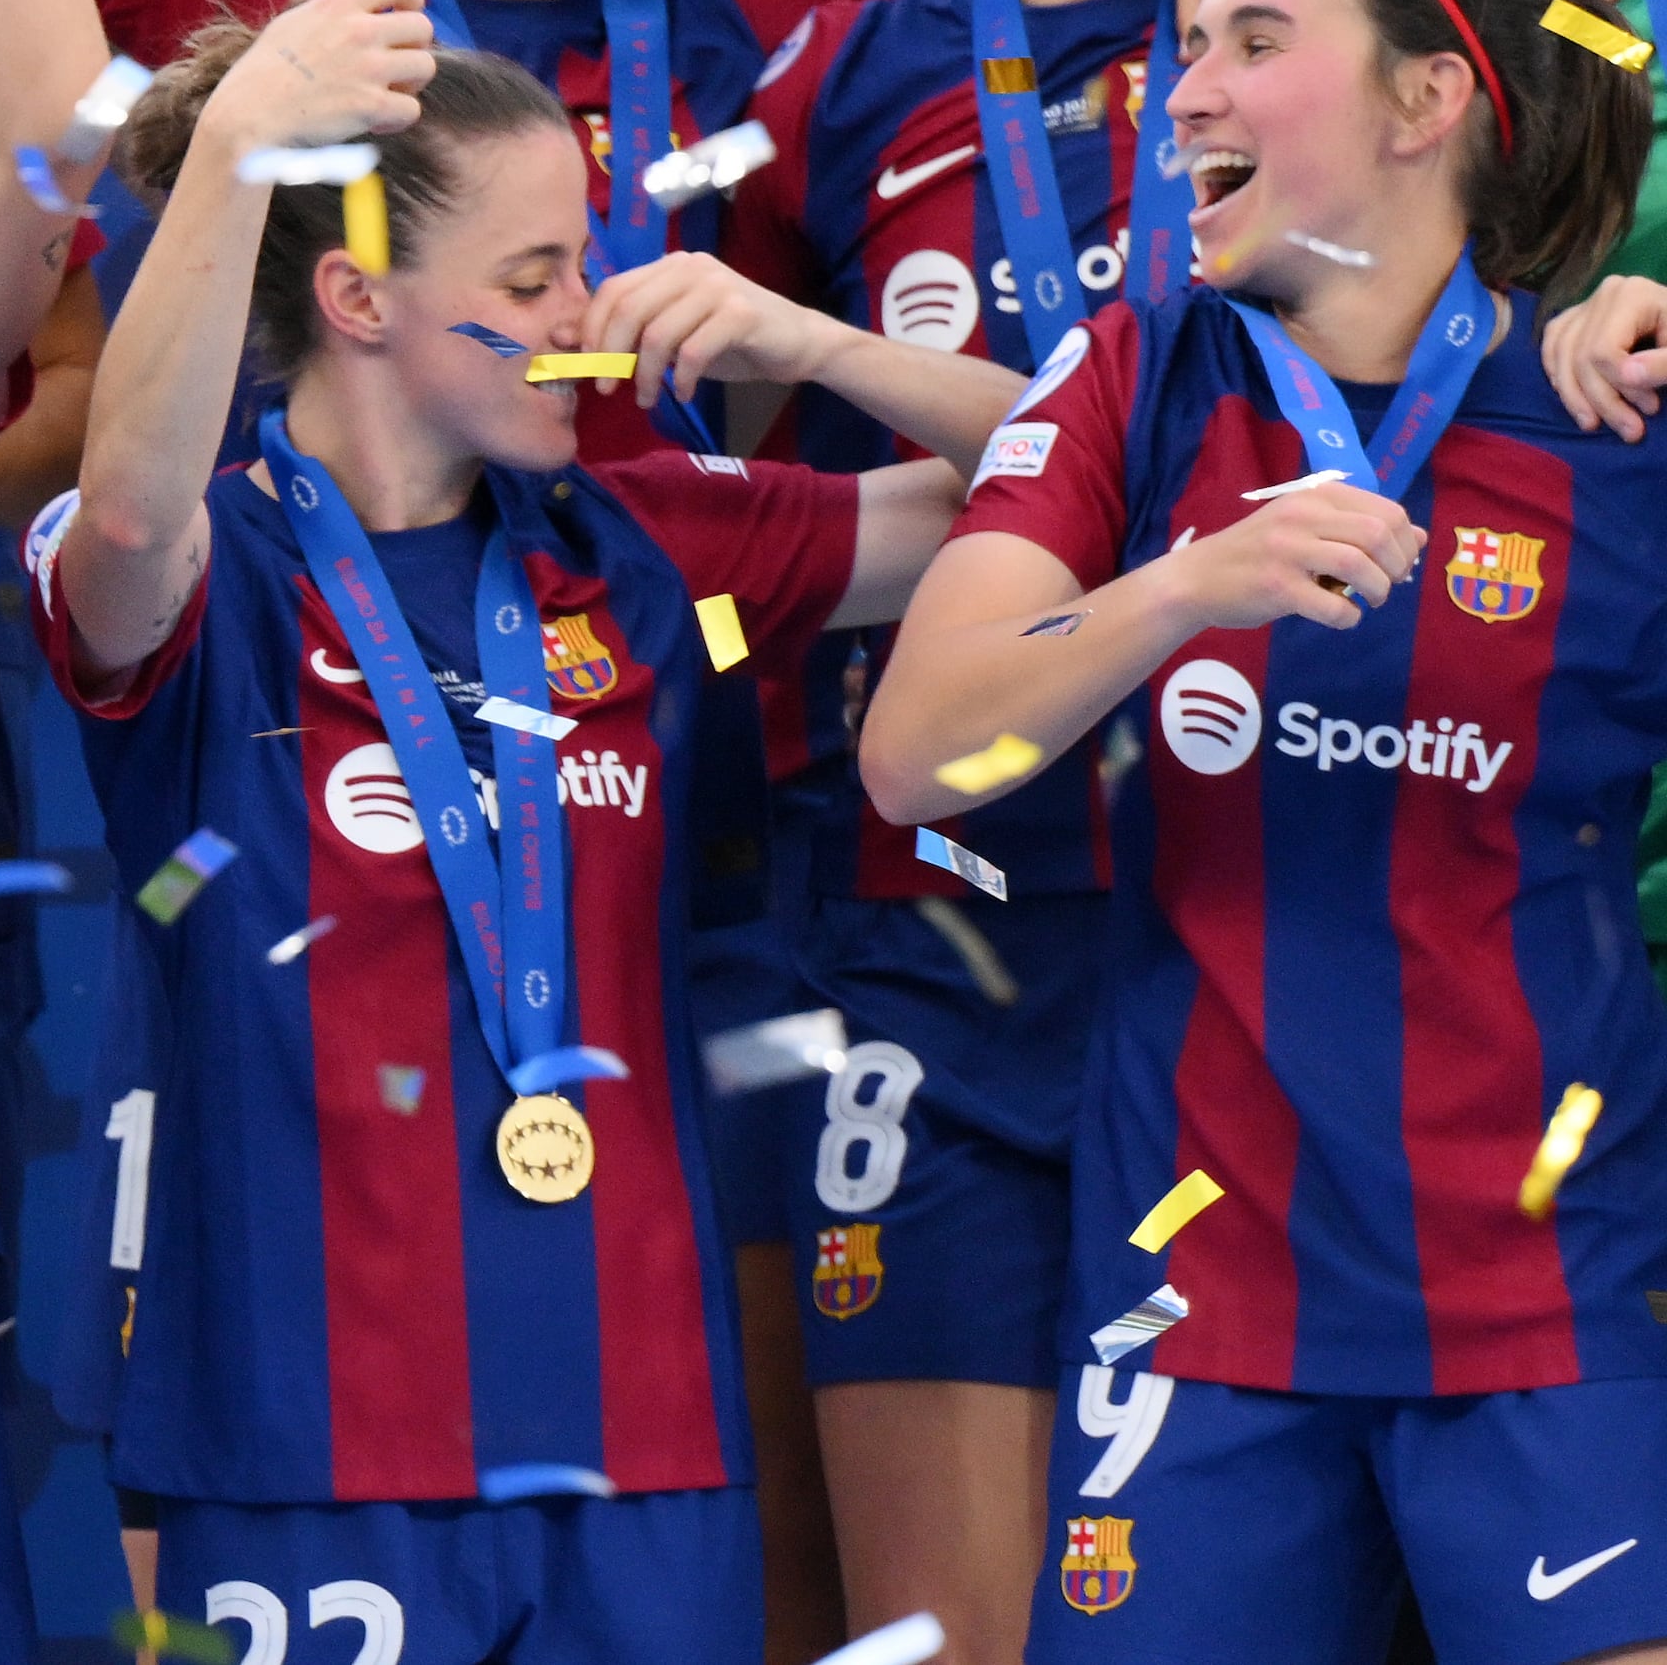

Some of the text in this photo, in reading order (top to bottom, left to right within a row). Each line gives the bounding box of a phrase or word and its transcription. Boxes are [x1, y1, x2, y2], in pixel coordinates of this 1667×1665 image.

[1391, 390, 1436, 456] BILBAO
[334, 556, 379, 618] BILBAO
[380, 654, 436, 750] FINAL
[431, 669, 462, 685] NAL
[1273, 700, 1514, 794] Spotify
[520, 832, 544, 911] BILBAO
[814, 1040, 925, 1214] 8
